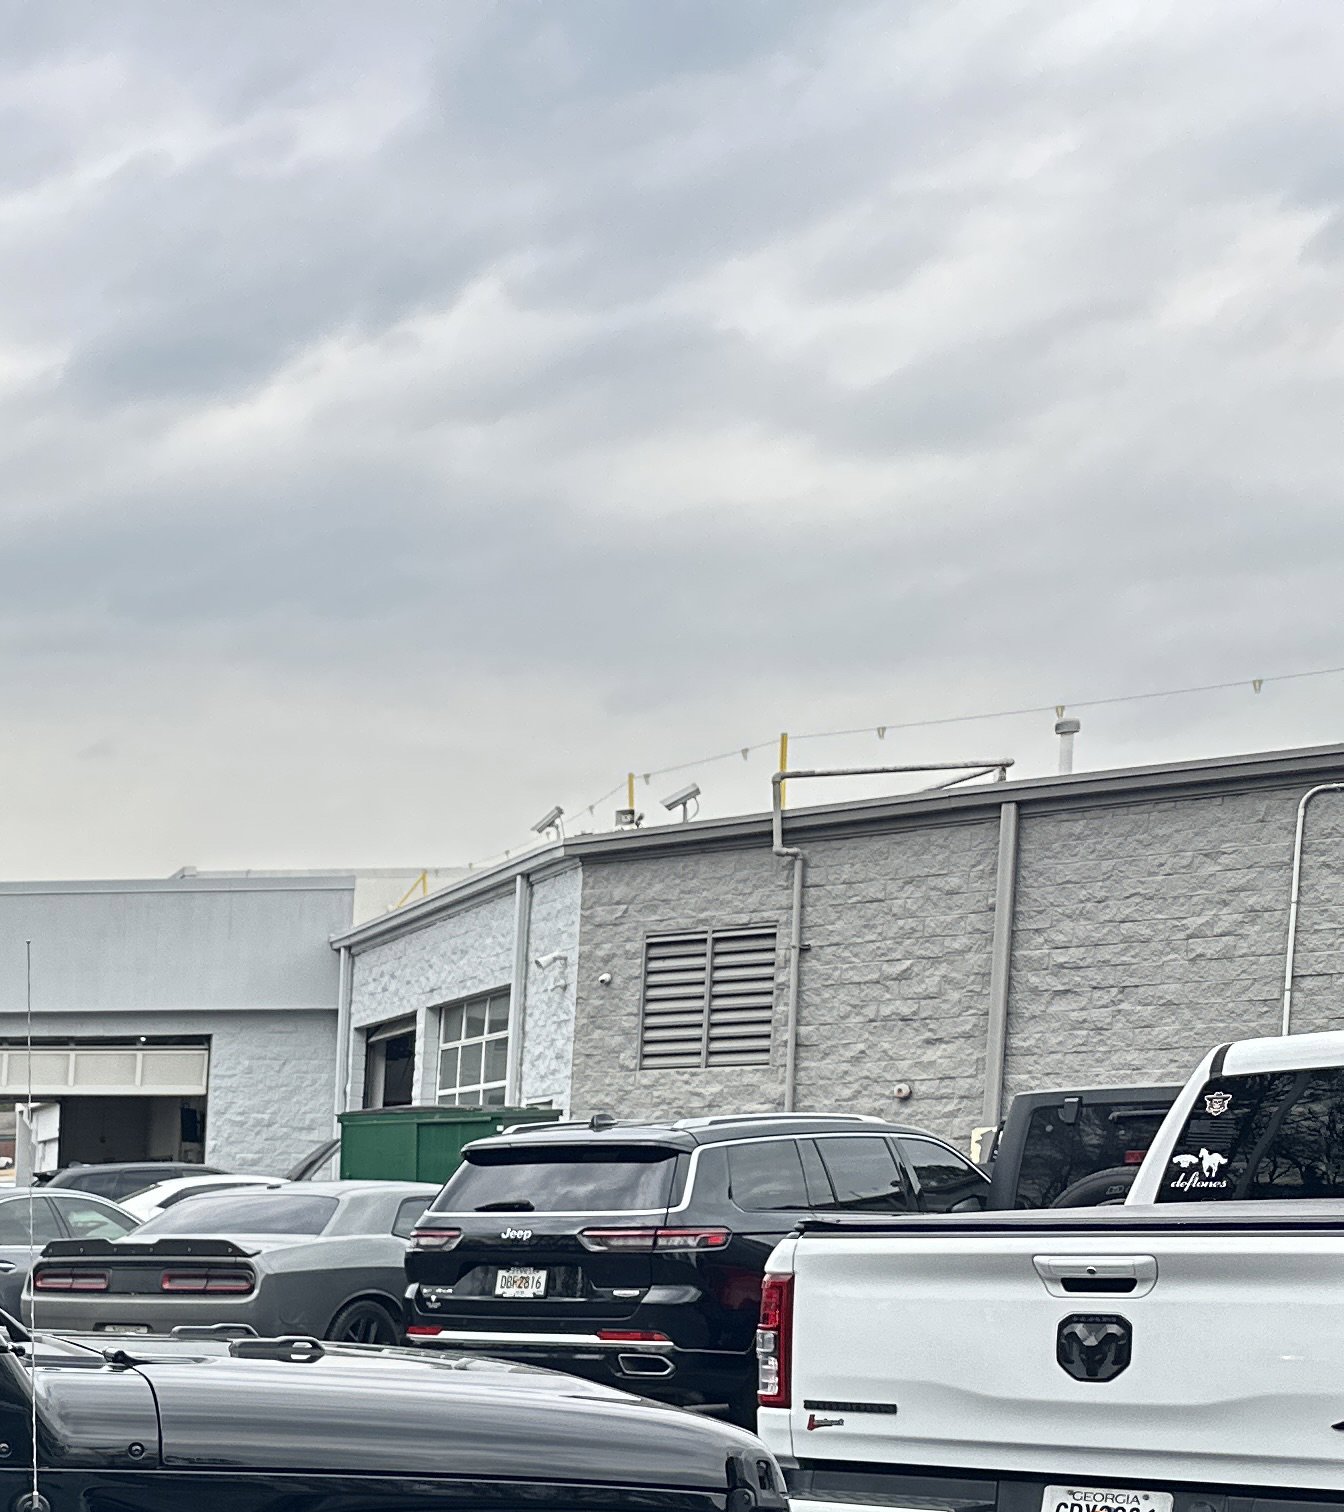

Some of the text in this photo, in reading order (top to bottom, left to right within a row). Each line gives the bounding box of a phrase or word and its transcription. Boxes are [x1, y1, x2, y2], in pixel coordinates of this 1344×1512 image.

[1170, 1171, 1227, 1192] deftones
[501, 1228, 532, 1240] Jeep
[1072, 1490, 1141, 1506] GEORGIA
